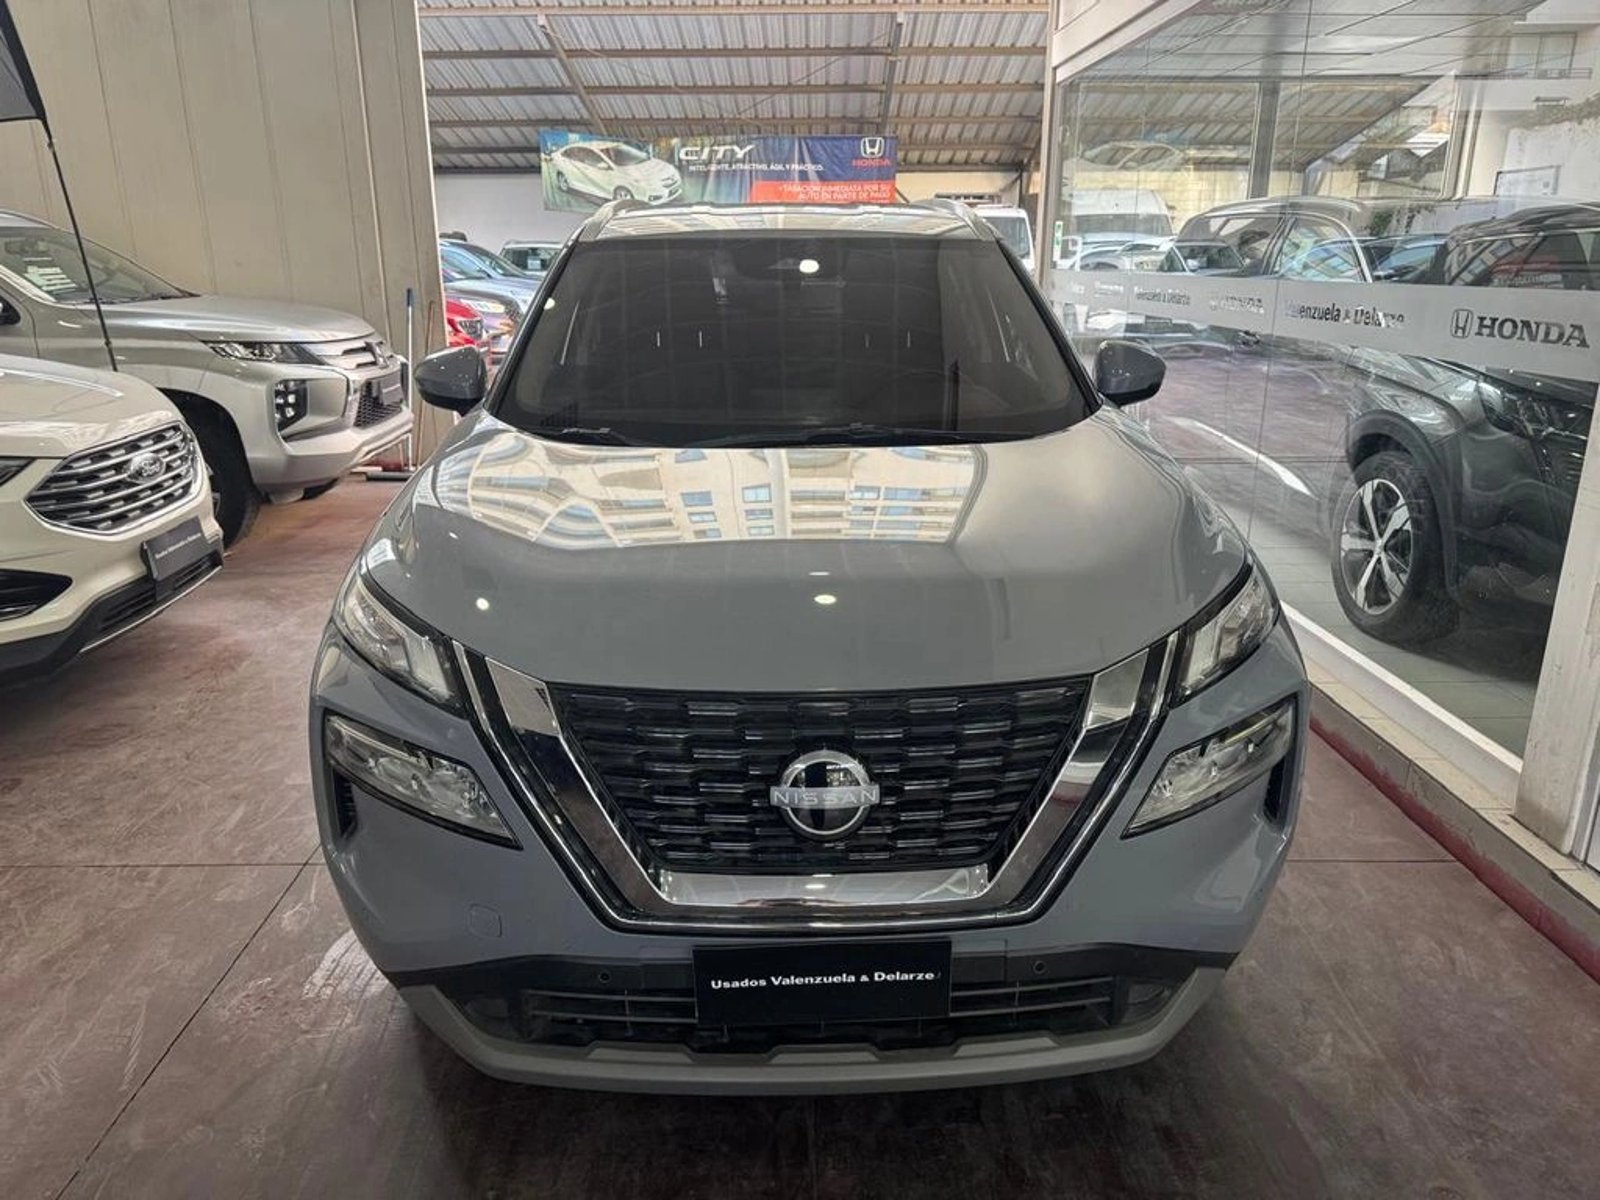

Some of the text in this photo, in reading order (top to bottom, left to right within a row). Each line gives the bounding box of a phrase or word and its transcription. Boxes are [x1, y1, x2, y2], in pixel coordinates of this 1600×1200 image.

[679, 145, 756, 160] CITY
[852, 159, 891, 168] HONDA
[1475, 315, 1590, 349] HONDA
[773, 790, 878, 805] NISSAN
[710, 971, 935, 990] Usados Valenzuela & Delarze
